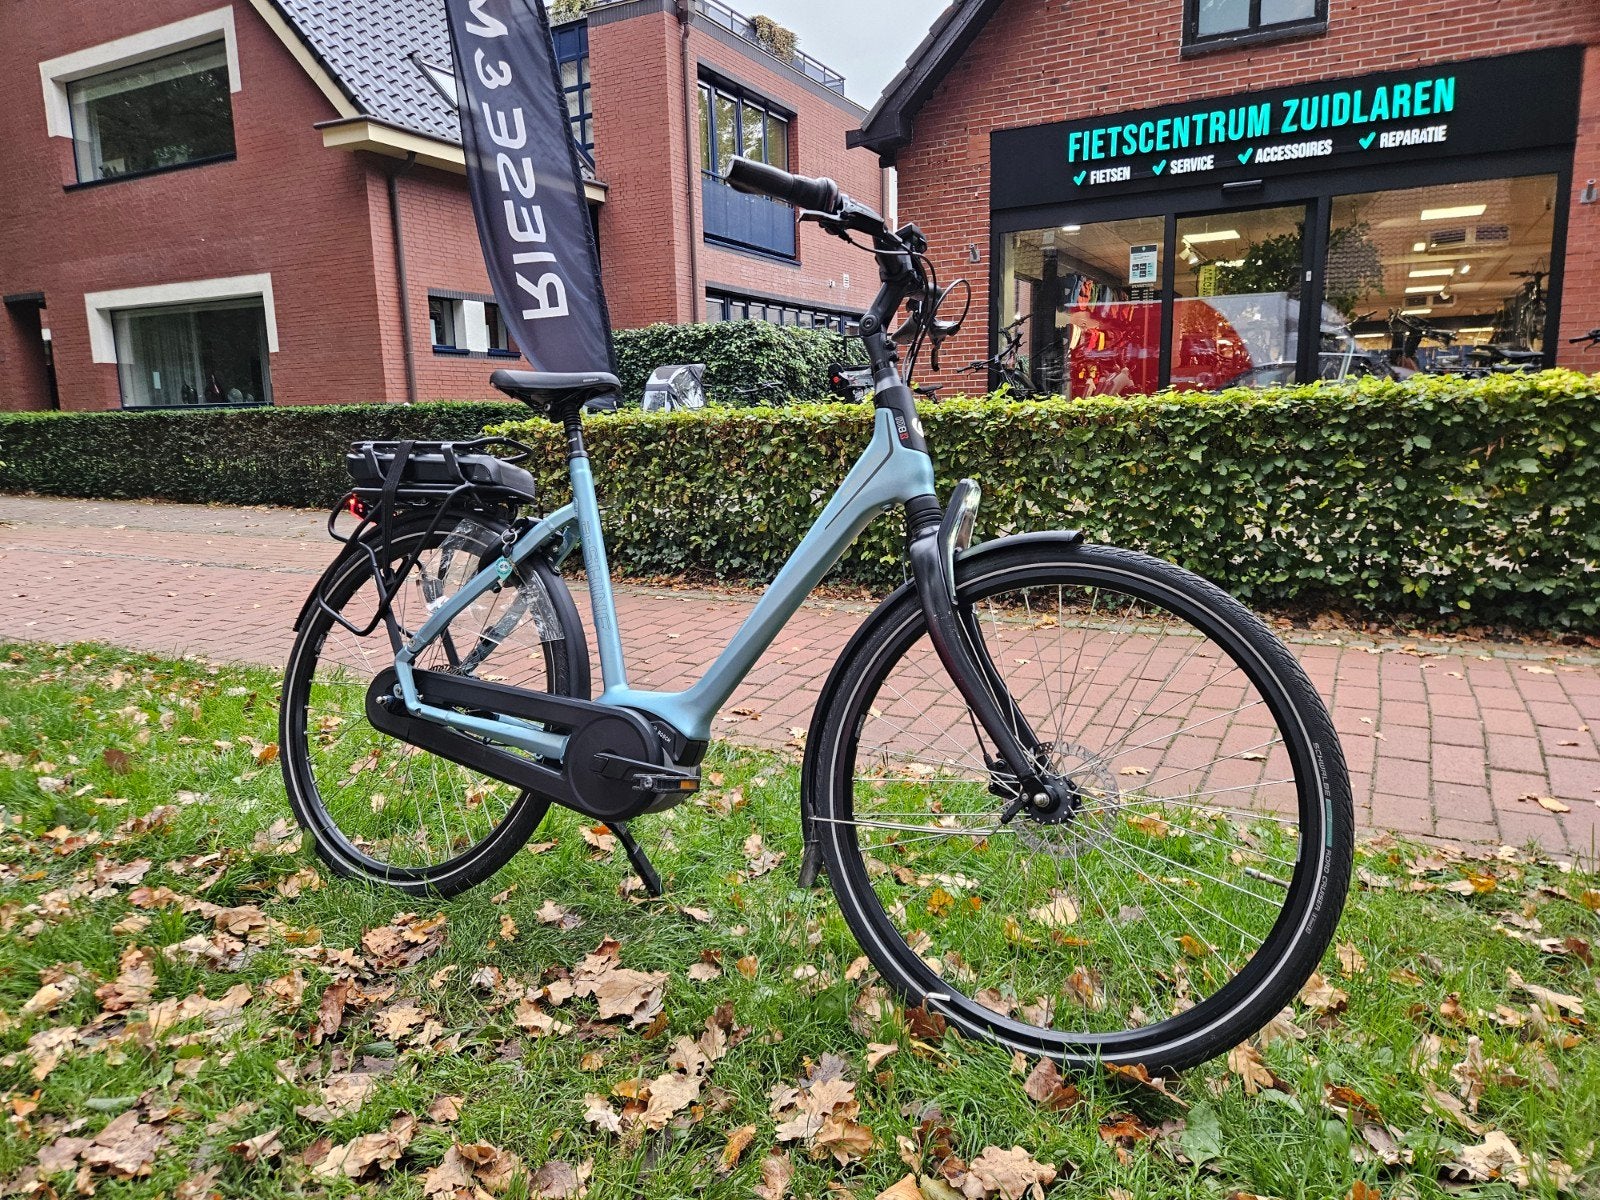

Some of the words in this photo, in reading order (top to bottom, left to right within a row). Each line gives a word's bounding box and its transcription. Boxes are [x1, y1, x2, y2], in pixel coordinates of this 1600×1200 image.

[1068, 102, 1271, 163] FIETSCENTRUM
[1280, 76, 1456, 133] ZUIDLAREN
[1089, 166, 1131, 185] FIETSEN
[1170, 155, 1214, 175] SERVICE
[1254, 139, 1333, 164] ACCESSOIRES
[1379, 125, 1447, 149] REPARATIE
[1313, 742, 1331, 797] SCHWALBE
[1323, 848, 1332, 874] ROAD
[1313, 875, 1328, 912] CRUISER
